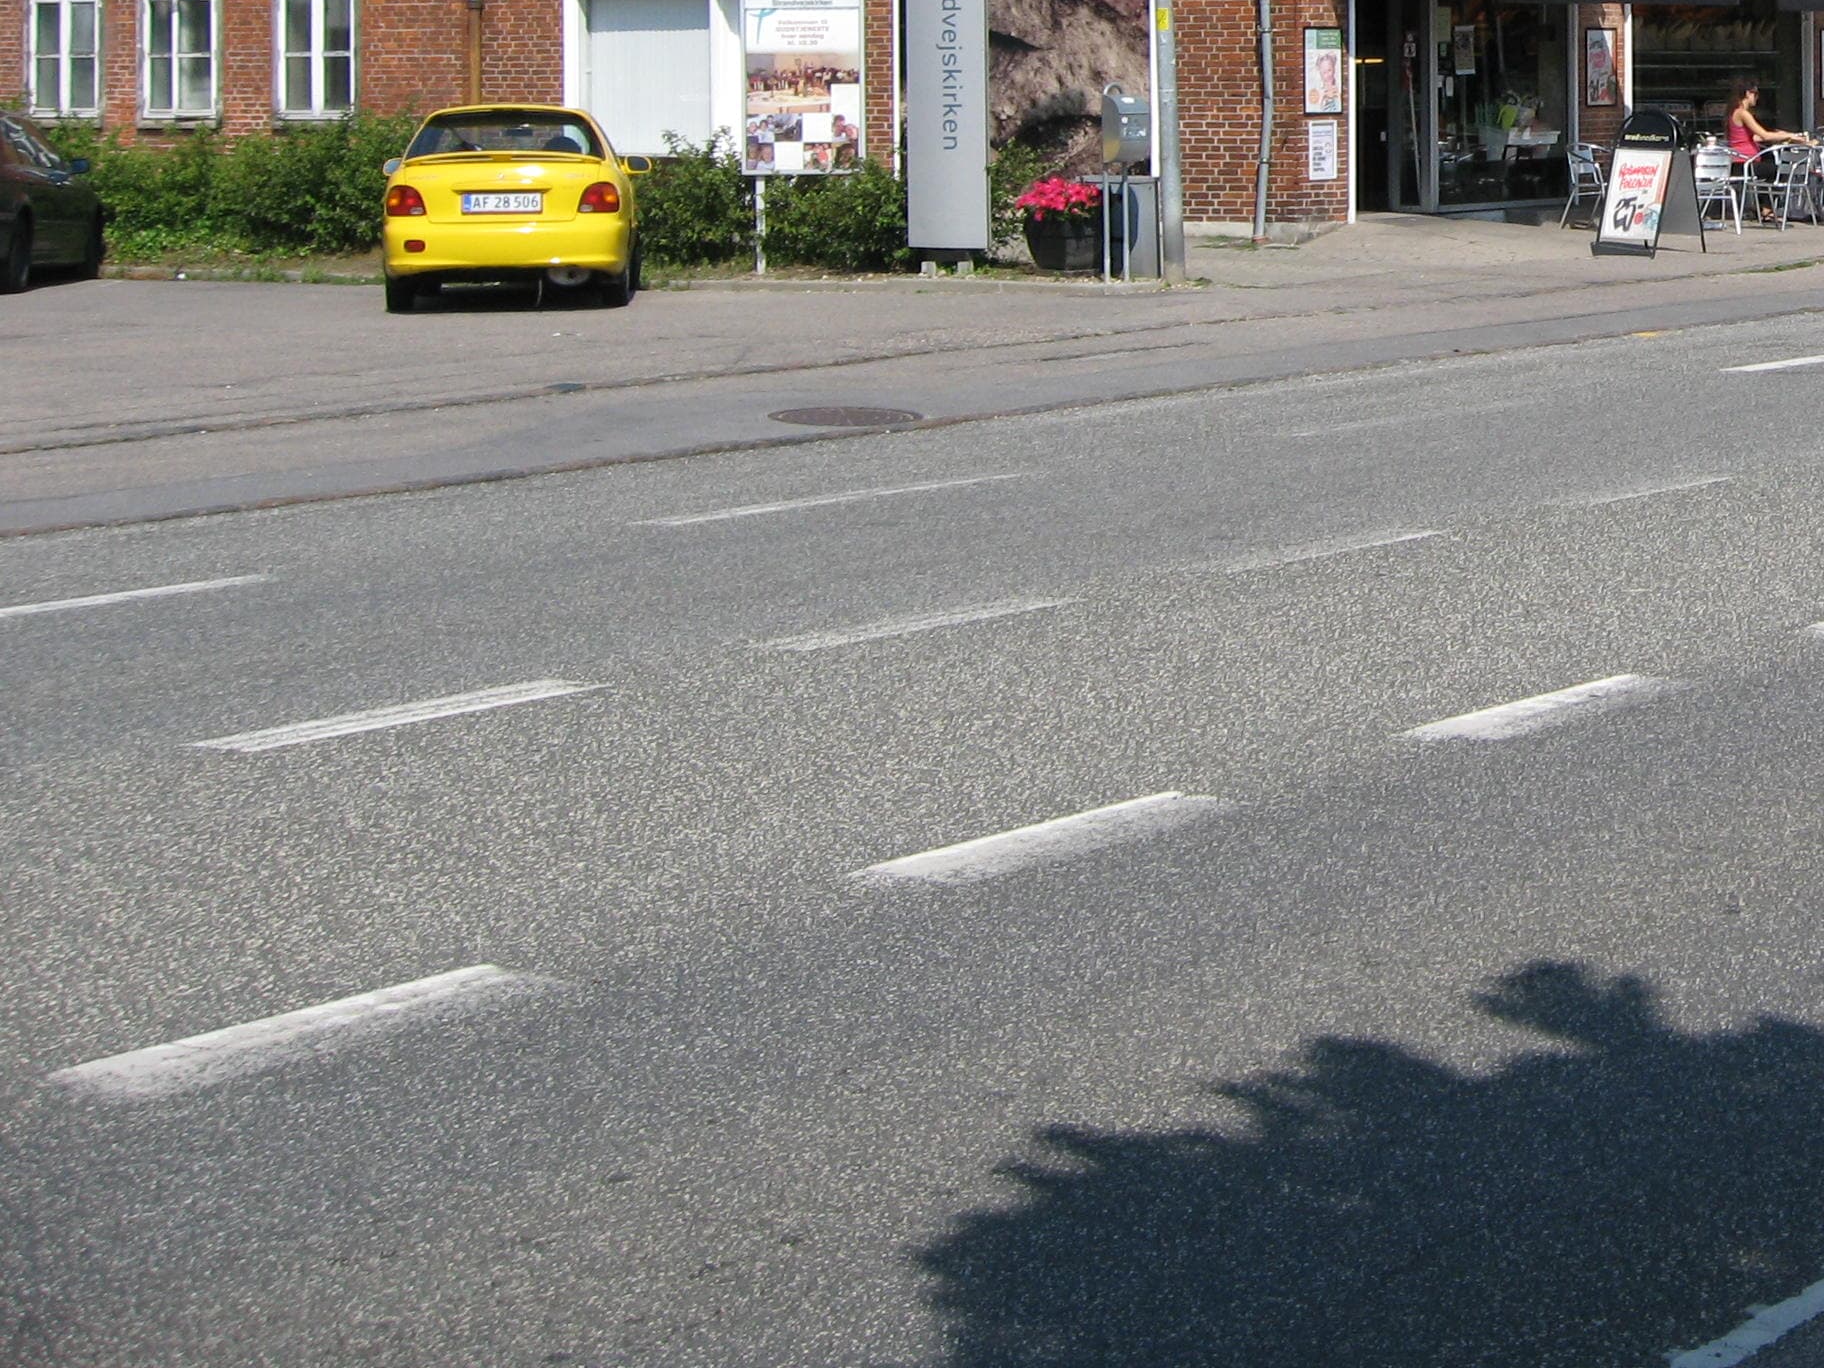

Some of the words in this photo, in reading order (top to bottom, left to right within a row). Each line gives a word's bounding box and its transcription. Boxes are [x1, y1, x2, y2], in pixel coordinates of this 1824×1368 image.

[473, 196, 489, 209] AF
[495, 195, 510, 208] 28
[514, 194, 539, 208] 506
